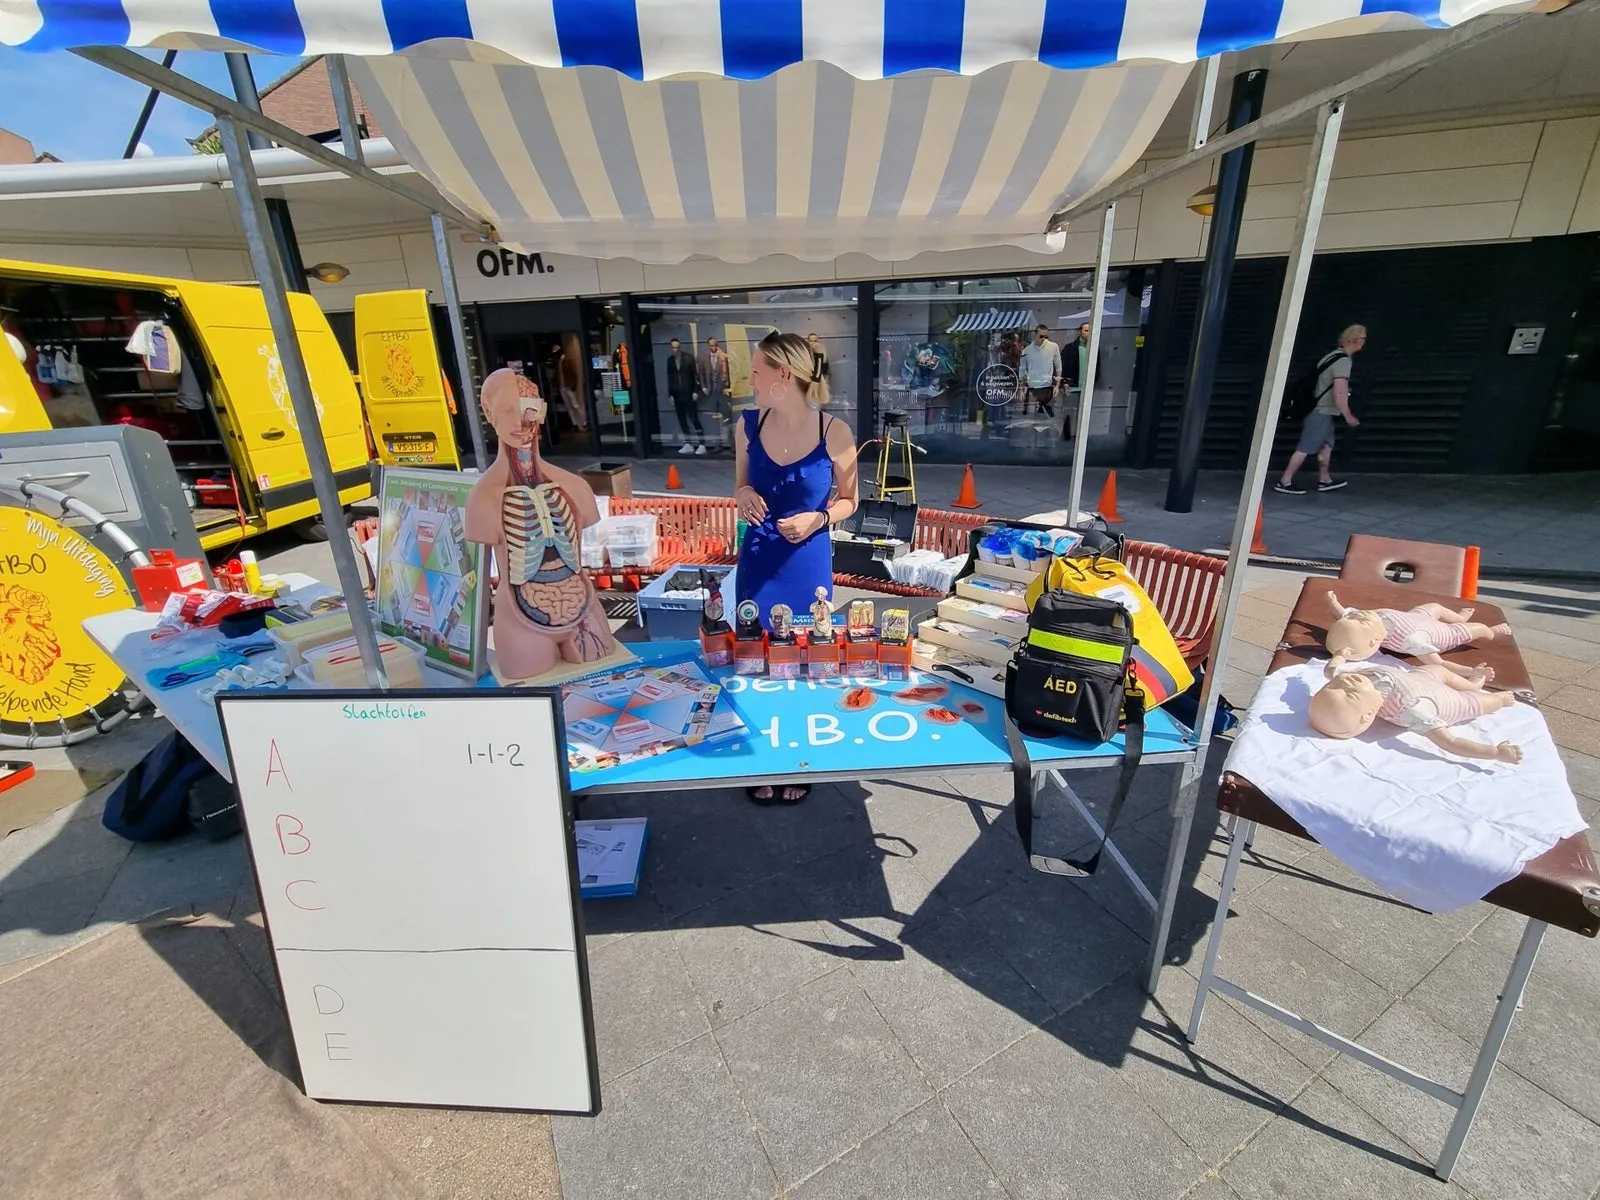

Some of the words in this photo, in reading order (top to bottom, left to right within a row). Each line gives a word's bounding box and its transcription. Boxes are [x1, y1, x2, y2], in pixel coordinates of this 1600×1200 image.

[477, 248, 555, 278] OFM.
[0, 684, 68, 714] elpende
[54, 662, 96, 701] Hand
[1043, 676, 1077, 694] AED
[1043, 711, 1077, 724] defibtech
[265, 738, 294, 793] A
[467, 743, 525, 767] 1-1-2
[275, 814, 311, 855] B
[285, 879, 325, 911] C
[313, 984, 345, 1015] D
[325, 1033, 352, 1061] E
